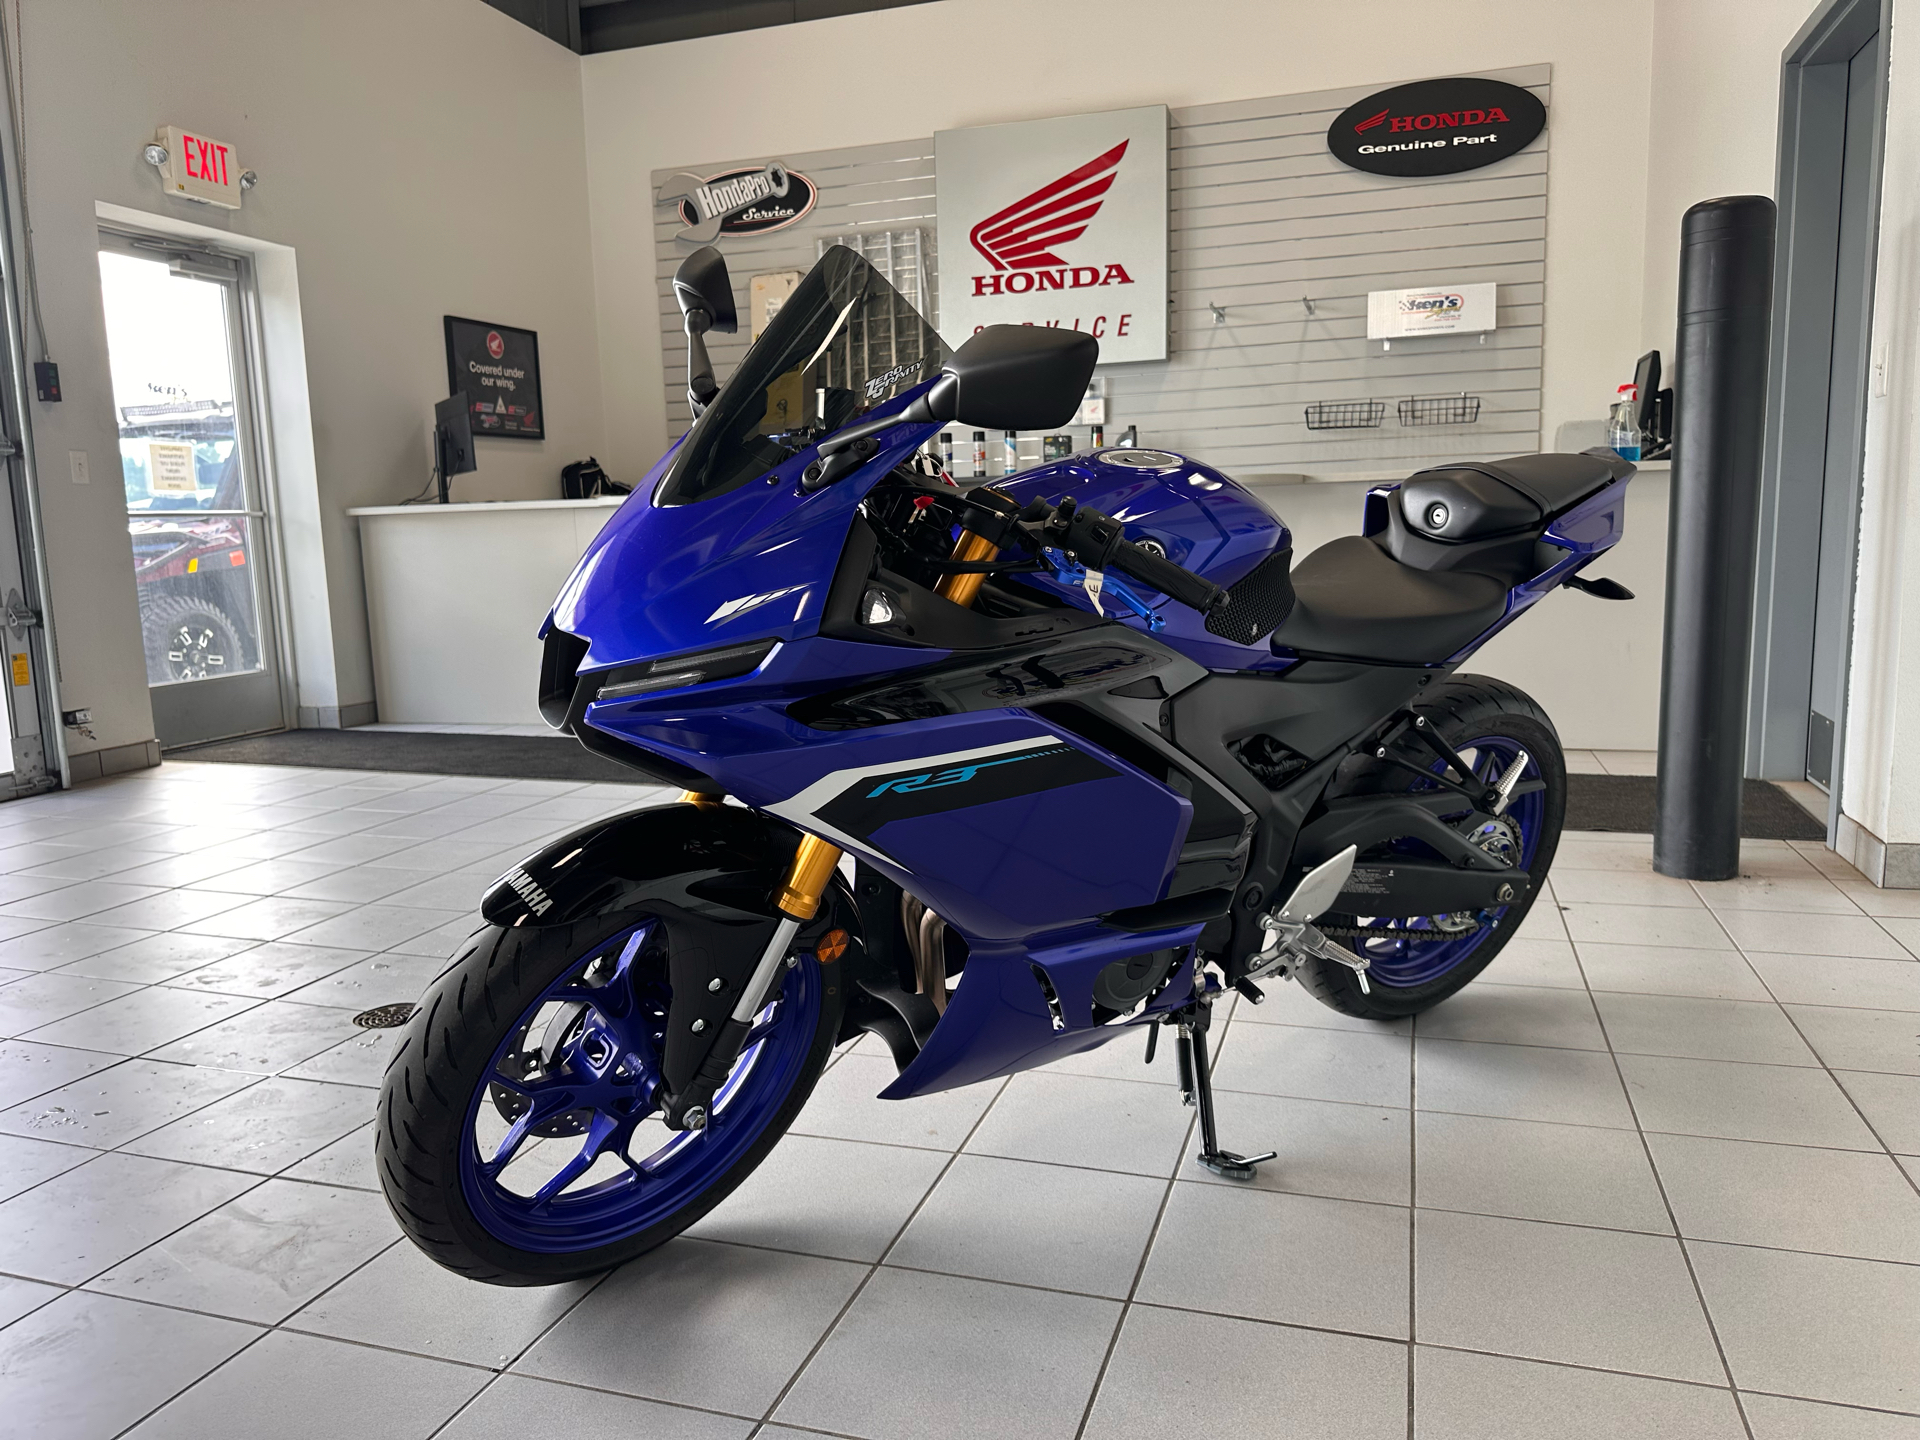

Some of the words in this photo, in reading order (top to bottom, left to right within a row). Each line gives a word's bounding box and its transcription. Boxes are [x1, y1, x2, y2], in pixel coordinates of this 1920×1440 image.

[1389, 107, 1510, 133] HONDA
[182, 134, 229, 187] EXIT
[1357, 139, 1447, 155] Genuine
[1452, 133, 1498, 146] Part
[695, 175, 771, 220] HondaPro
[742, 205, 796, 221] Service
[971, 263, 1135, 297] HONDA
[469, 360, 503, 377] Covered
[503, 367, 526, 379] under
[481, 376, 495, 387] our
[495, 377, 517, 392] wing.
[865, 365, 903, 398] ZERO
[872, 358, 925, 399] GRAVITY
[865, 766, 980, 799] R3
